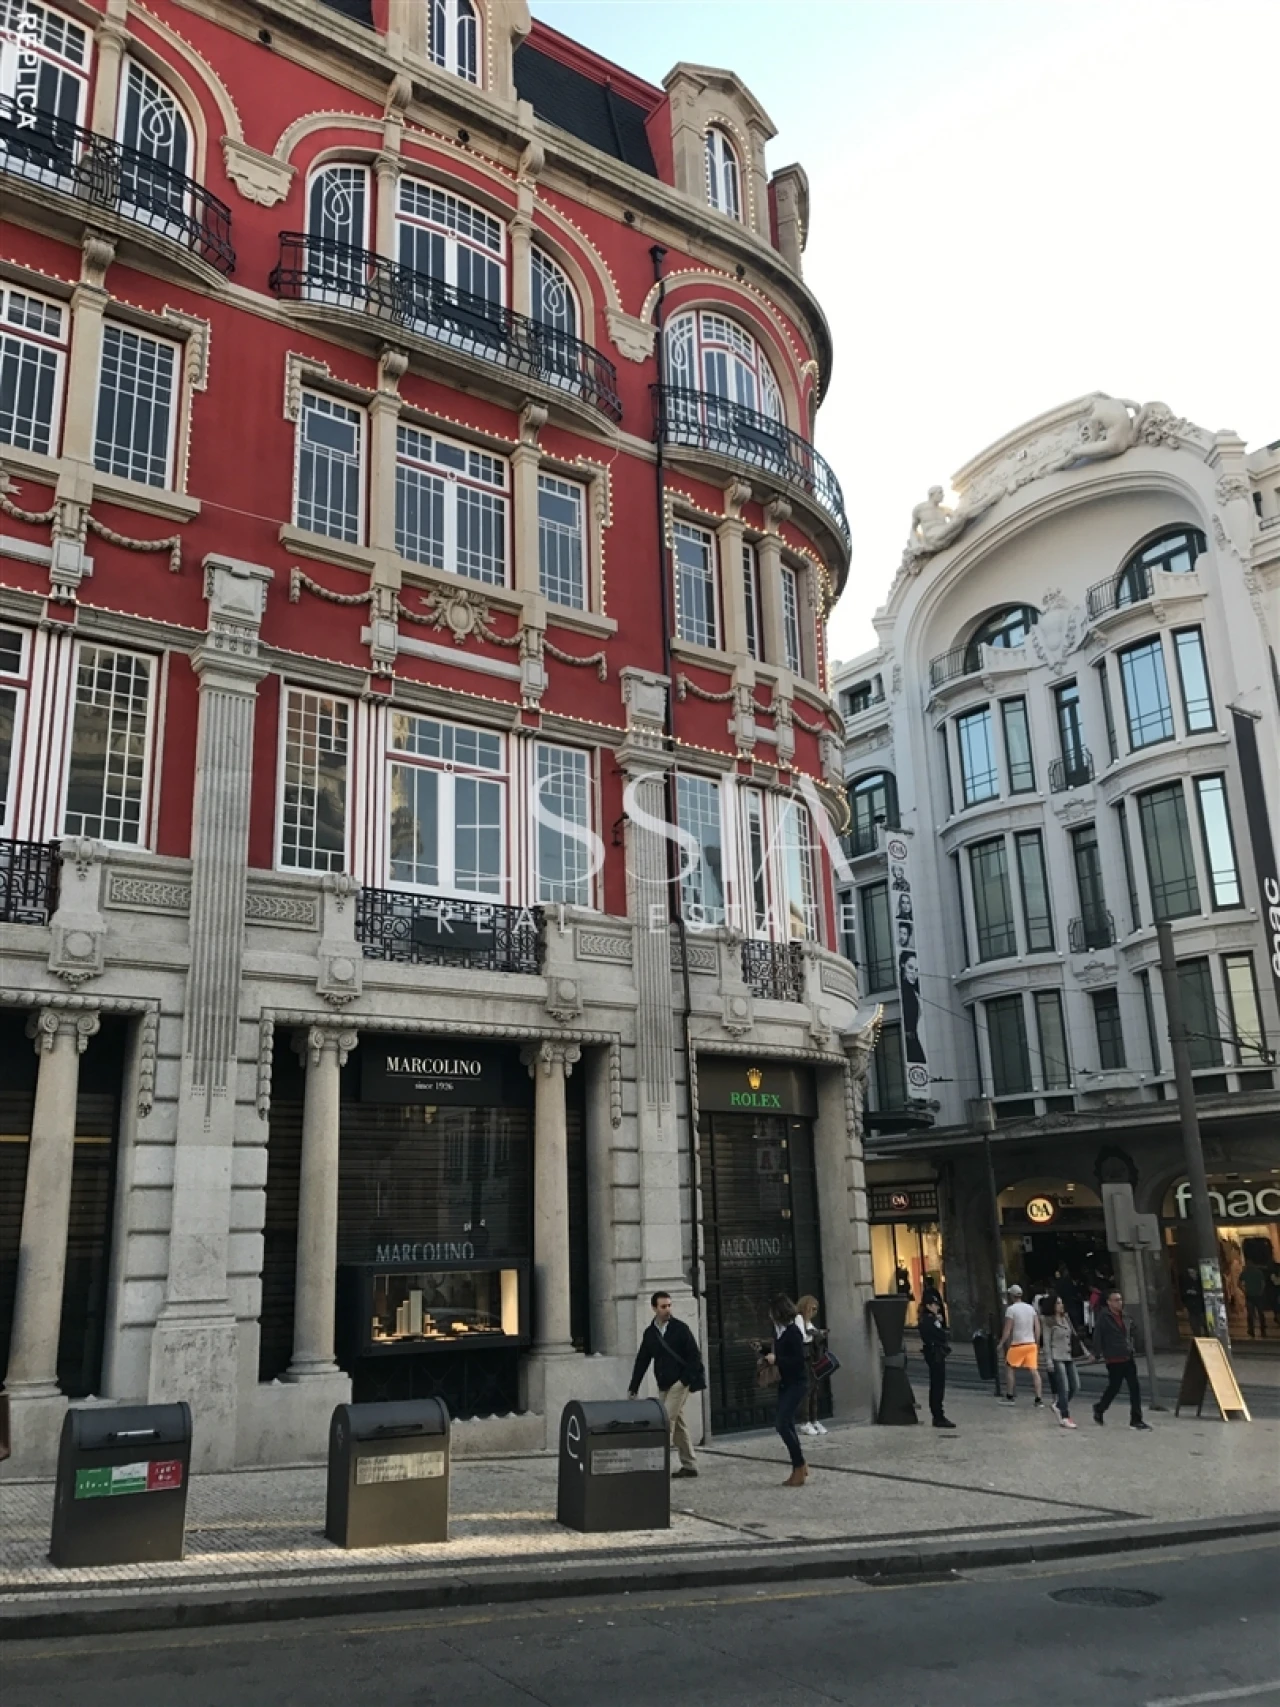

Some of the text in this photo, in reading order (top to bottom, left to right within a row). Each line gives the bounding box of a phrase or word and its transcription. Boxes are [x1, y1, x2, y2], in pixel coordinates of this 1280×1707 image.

[387, 1056, 482, 1076] MARCOLINO
[730, 1091, 782, 1108] ROLEX
[1029, 1202, 1051, 1217] C&A
[1175, 1181, 1280, 1219] fnac
[376, 1241, 475, 1262] MARCOLINO
